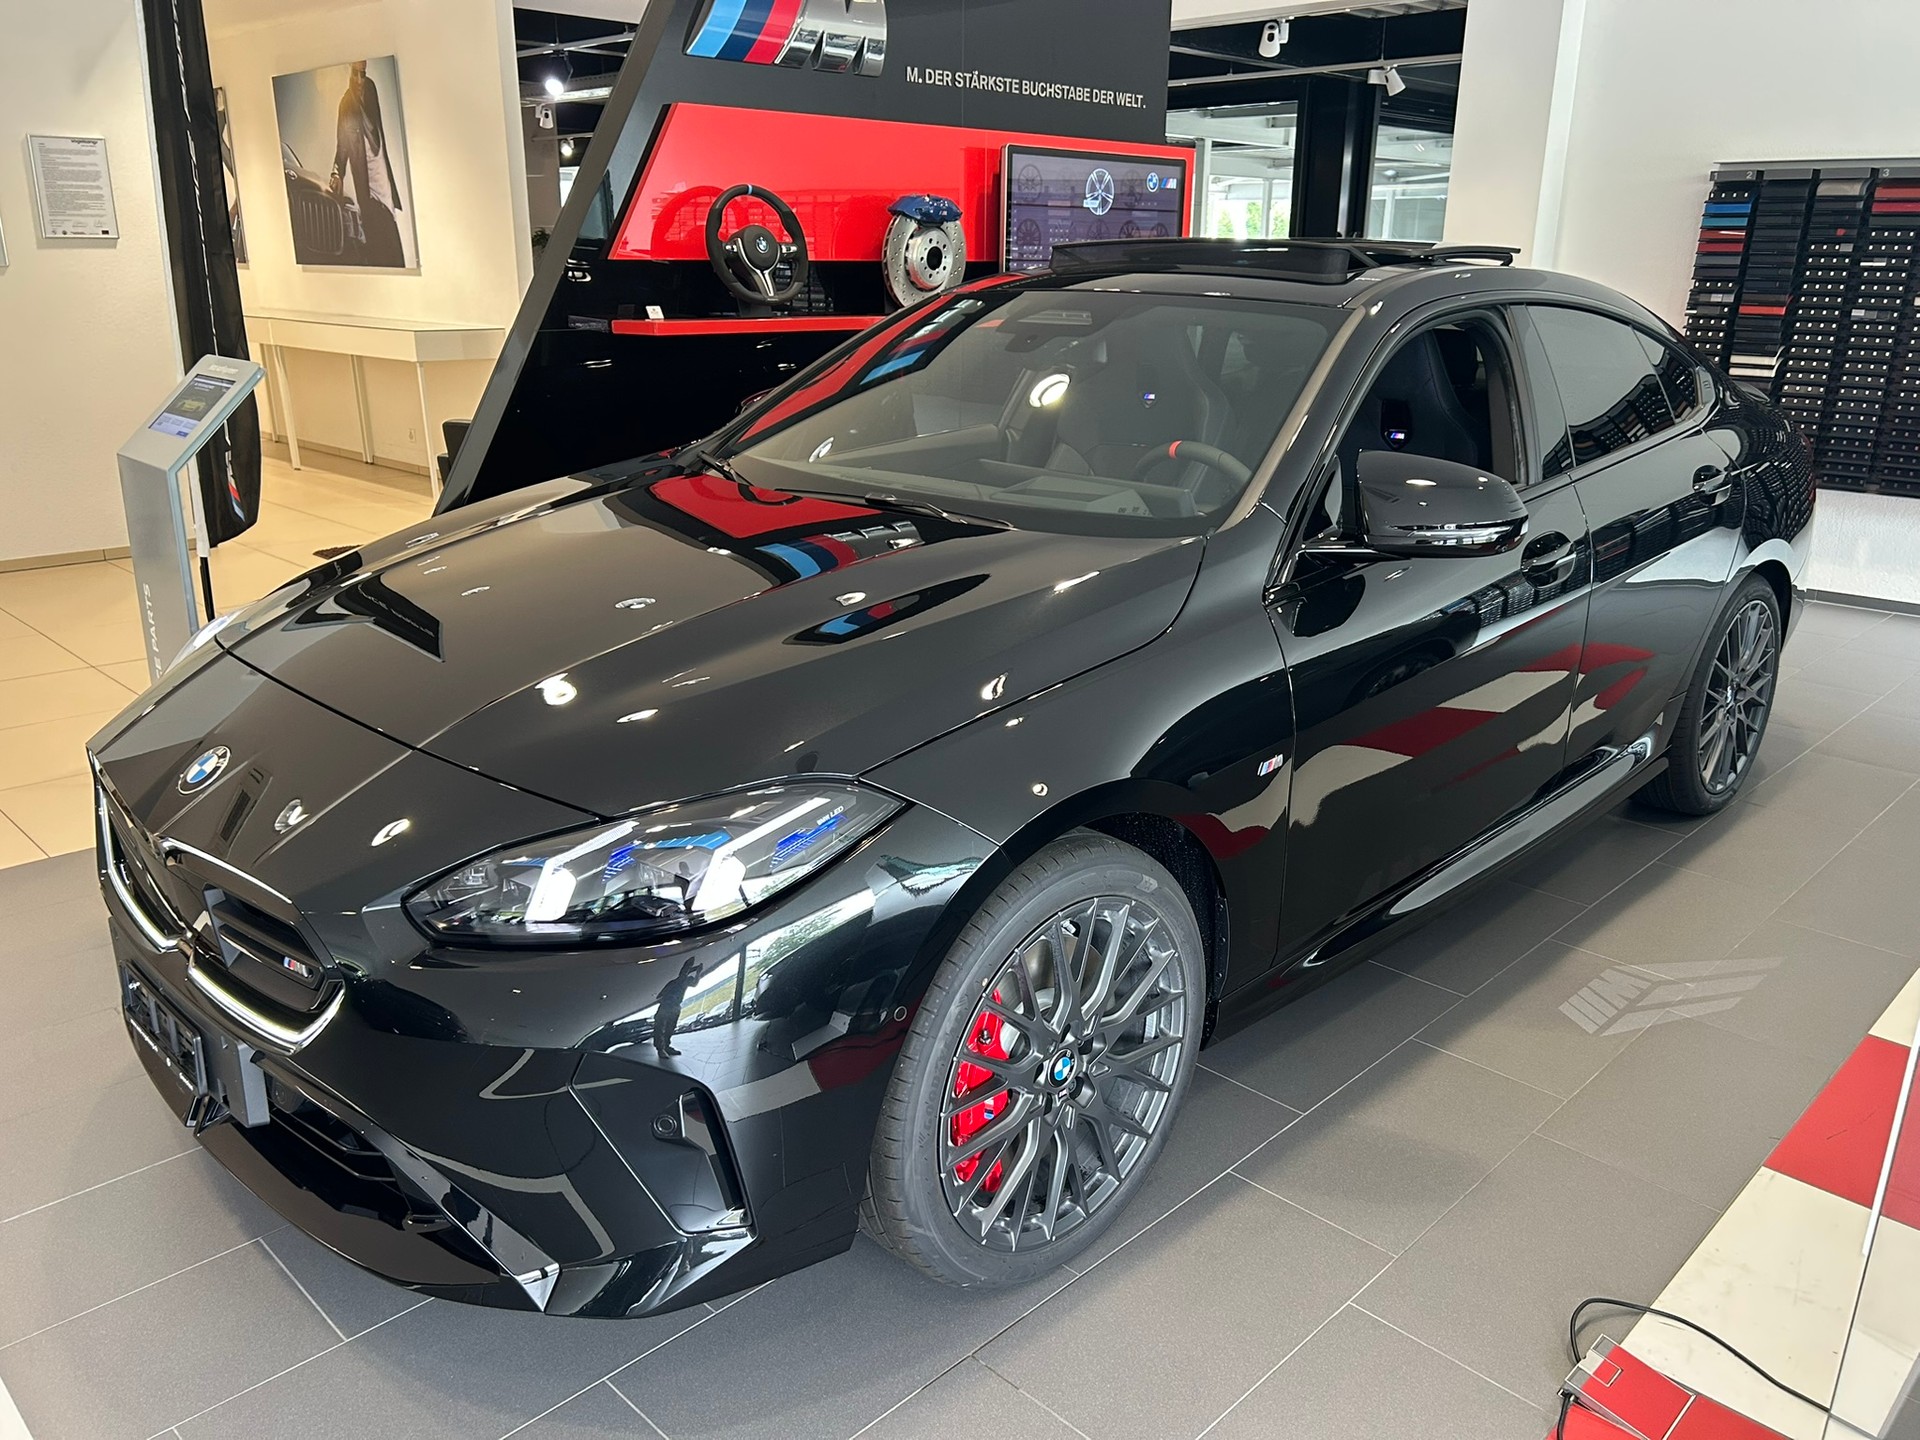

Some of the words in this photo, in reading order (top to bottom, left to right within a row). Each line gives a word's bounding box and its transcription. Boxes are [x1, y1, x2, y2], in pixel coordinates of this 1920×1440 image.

[906, 66, 923, 84] M.
[925, 68, 952, 87] DER
[954, 70, 1020, 95] STÄRKSTE
[1022, 79, 1091, 103] BUCHSTABE
[1092, 89, 1114, 105] DER
[1116, 92, 1147, 109] WELT.
[1745, 170, 1753, 180] 2
[1882, 168, 1890, 177] 3
[143, 583, 160, 653] PARTS
[830, 805, 844, 819] LED
